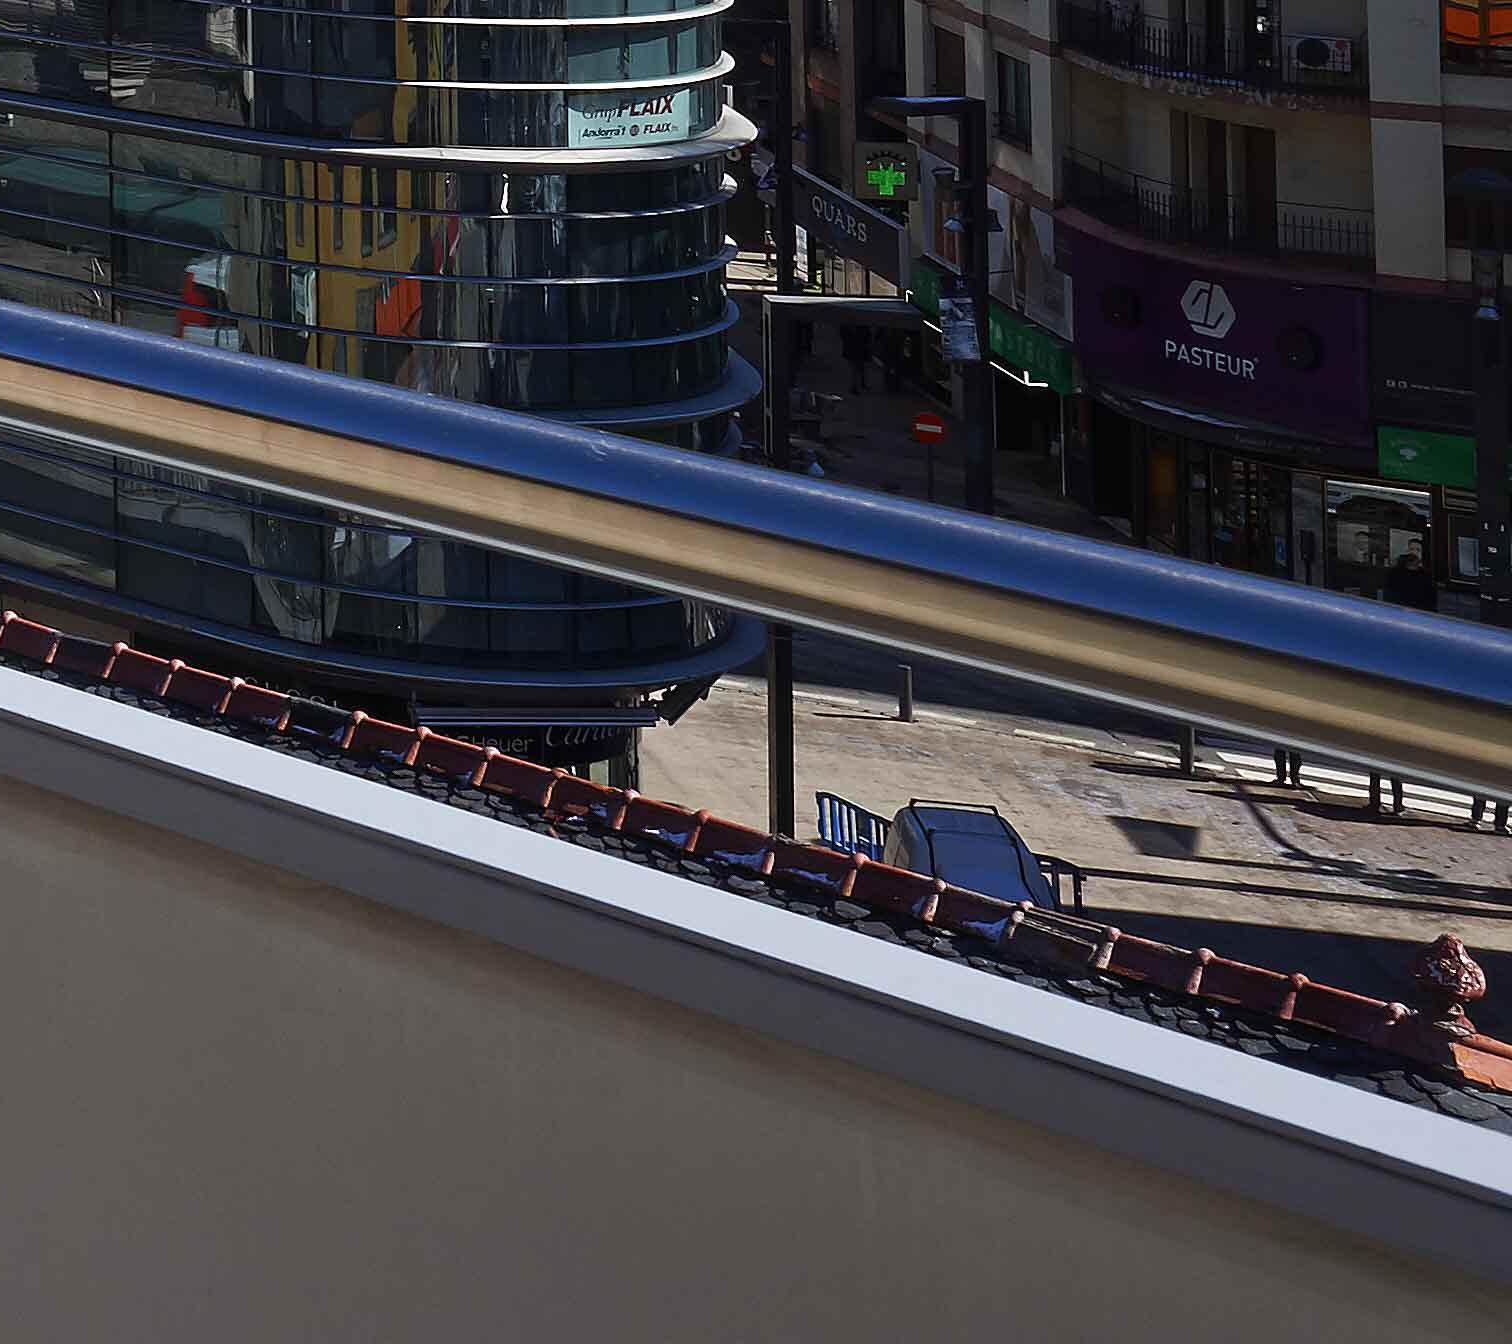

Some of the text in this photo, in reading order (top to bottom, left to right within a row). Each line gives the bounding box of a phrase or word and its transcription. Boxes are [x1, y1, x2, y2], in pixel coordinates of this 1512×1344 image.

[644, 123, 671, 134] FLAIX
[811, 195, 866, 242] QUARS
[1164, 339, 1256, 380] PASTEUR
